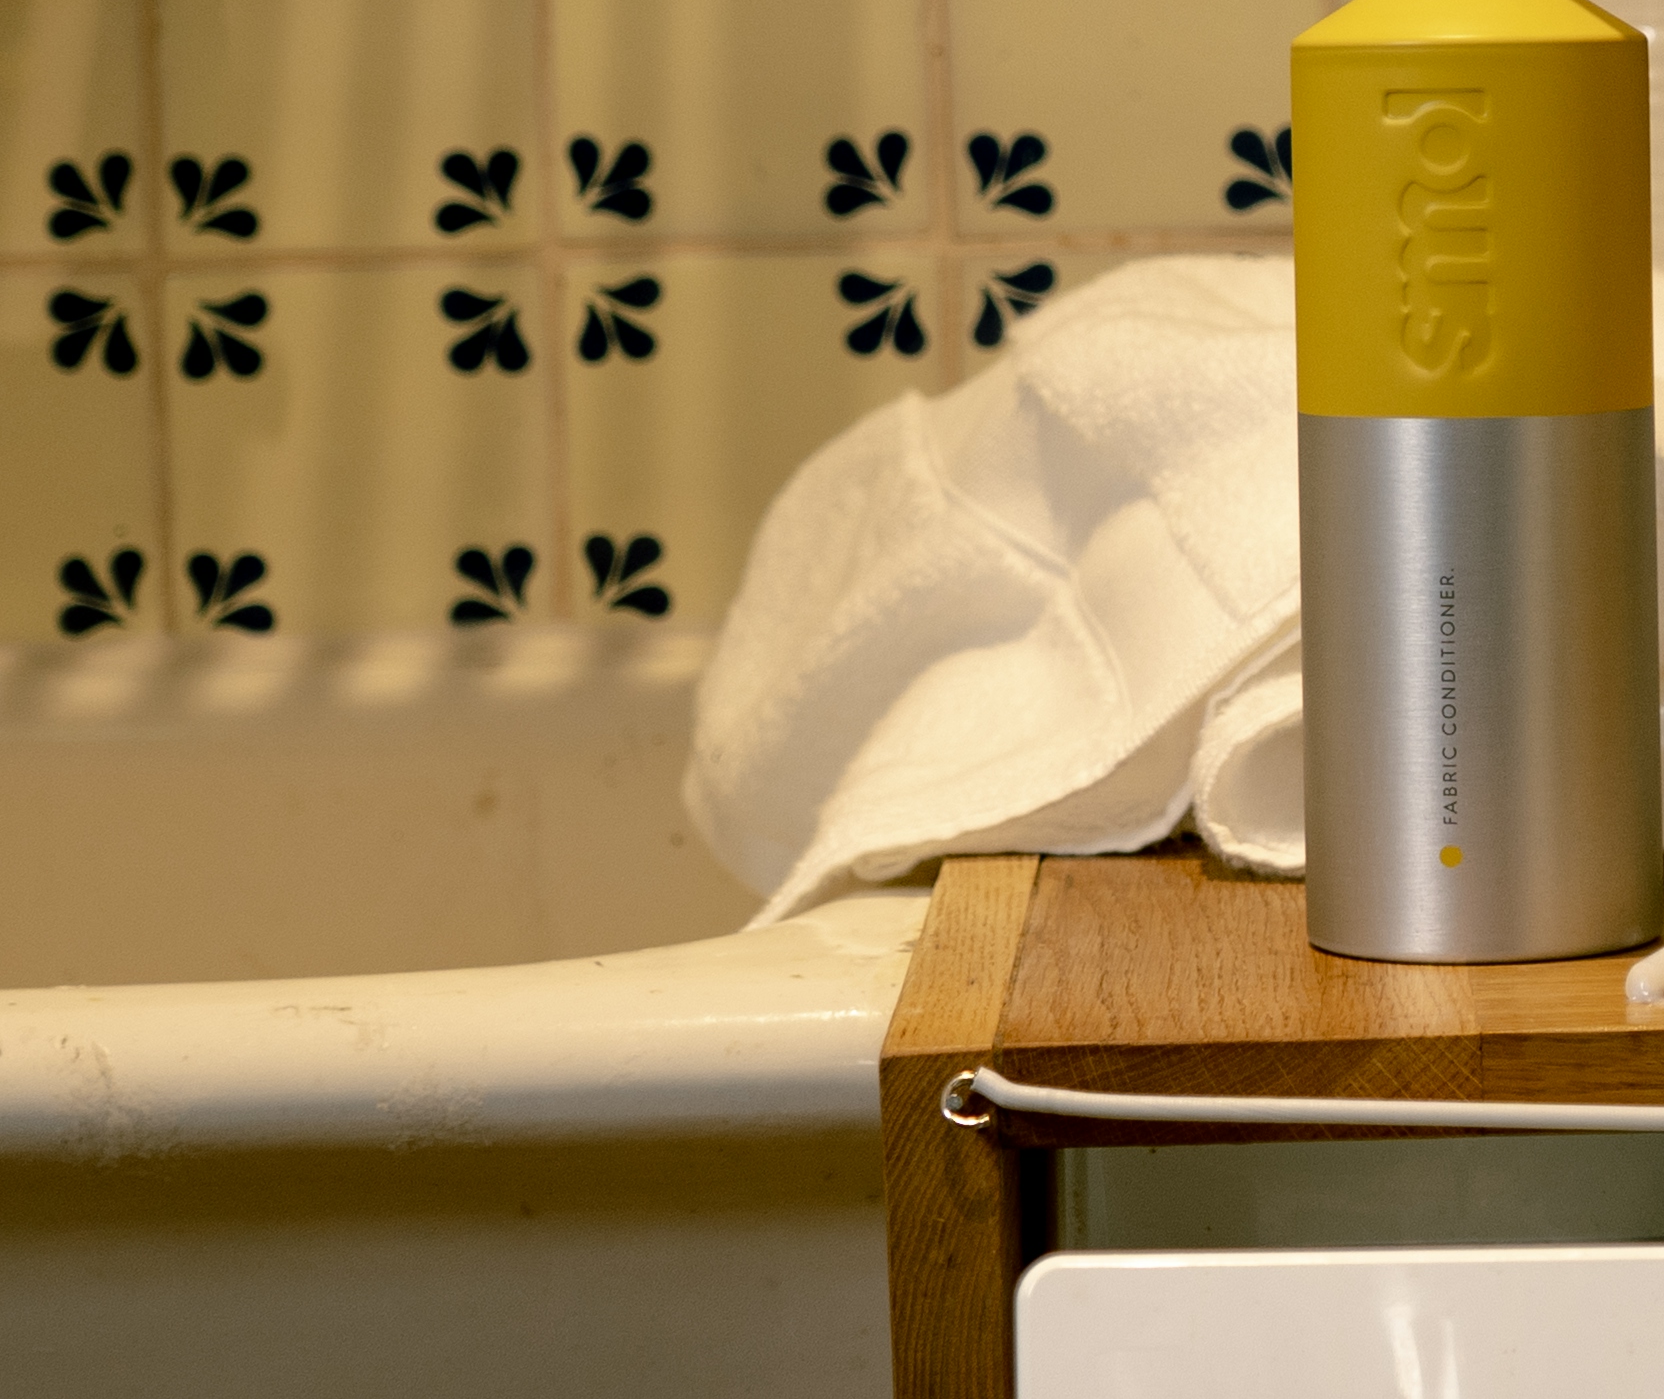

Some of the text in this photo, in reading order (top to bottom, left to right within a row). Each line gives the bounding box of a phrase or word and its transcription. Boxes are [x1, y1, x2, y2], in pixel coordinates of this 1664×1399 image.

[1382, 86, 1496, 381] smol
[1439, 567, 1458, 826] FABRIC CONDITIONER.
